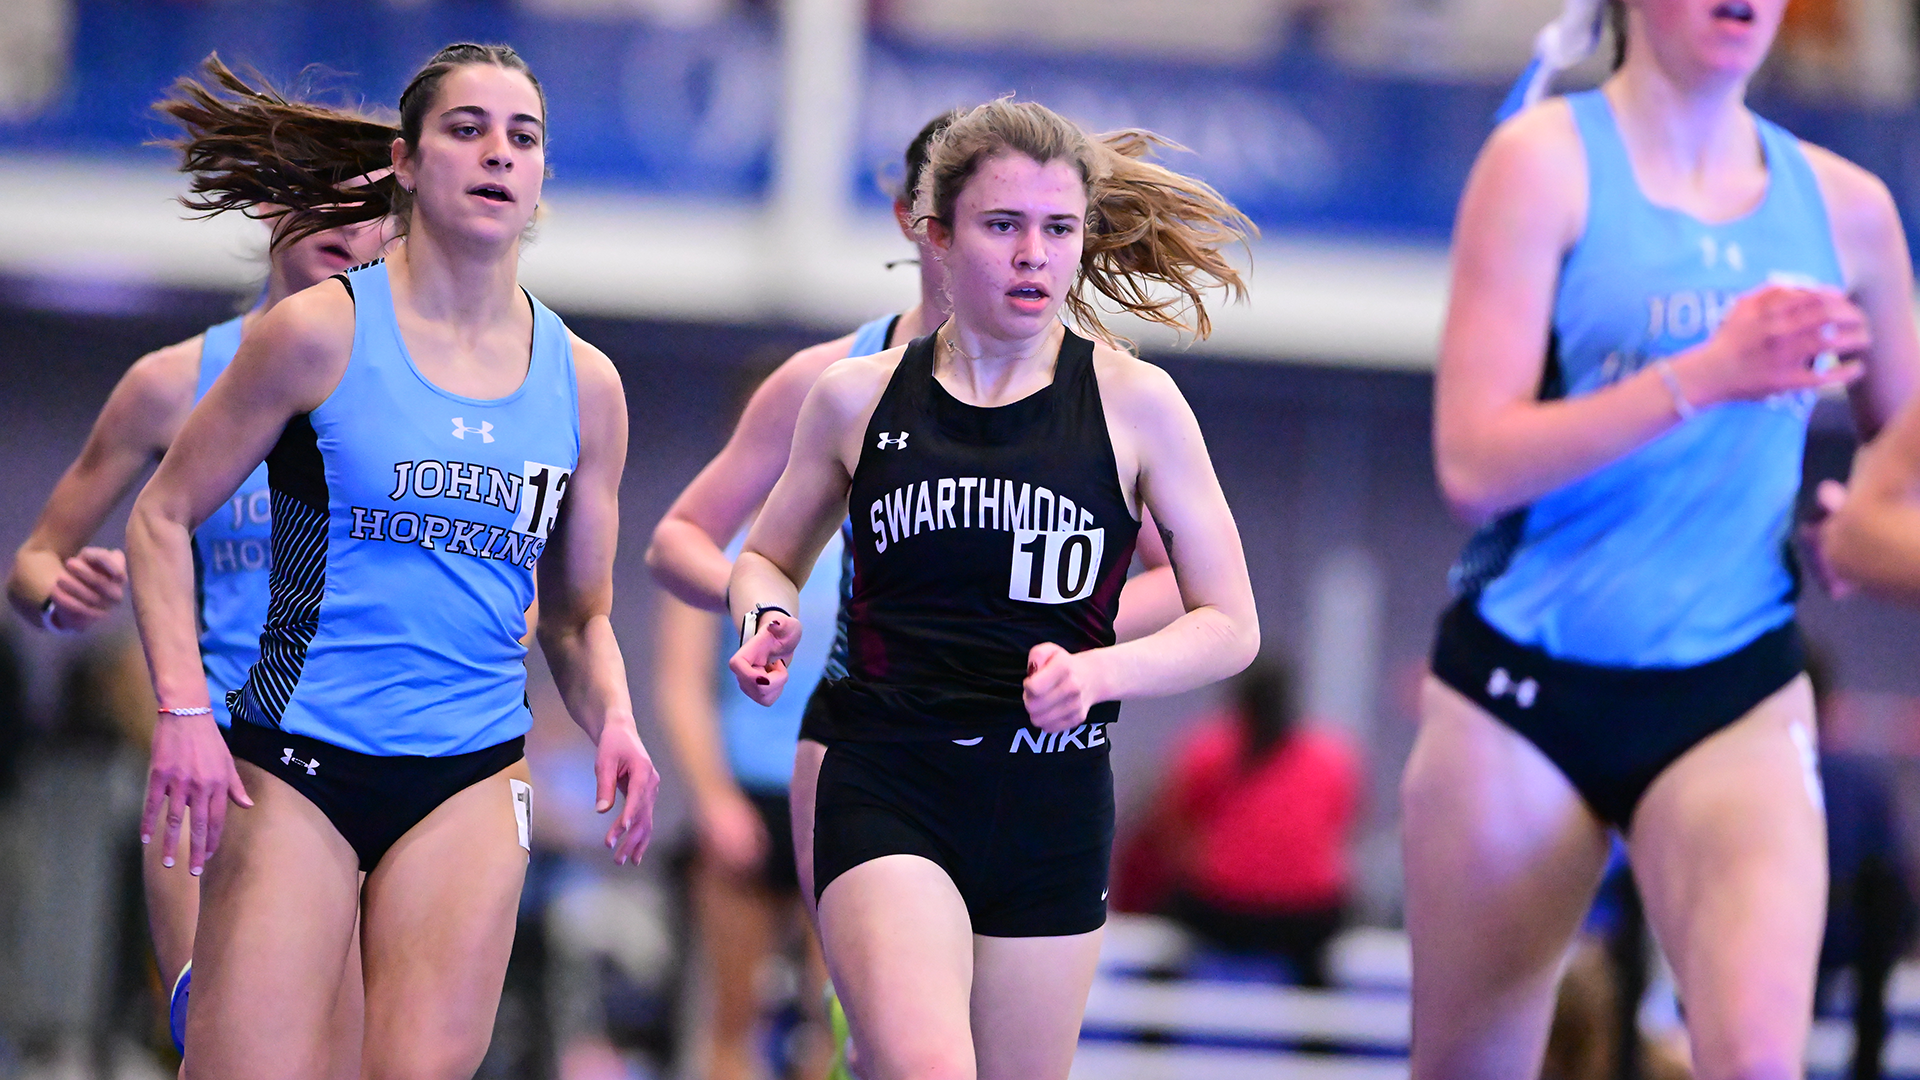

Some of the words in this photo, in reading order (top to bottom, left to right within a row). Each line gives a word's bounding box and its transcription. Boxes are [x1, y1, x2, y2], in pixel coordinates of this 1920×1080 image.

[350, 506, 547, 570] HOPKINS
[1021, 533, 1092, 599] 10
[1009, 722, 1106, 754] NIKE
